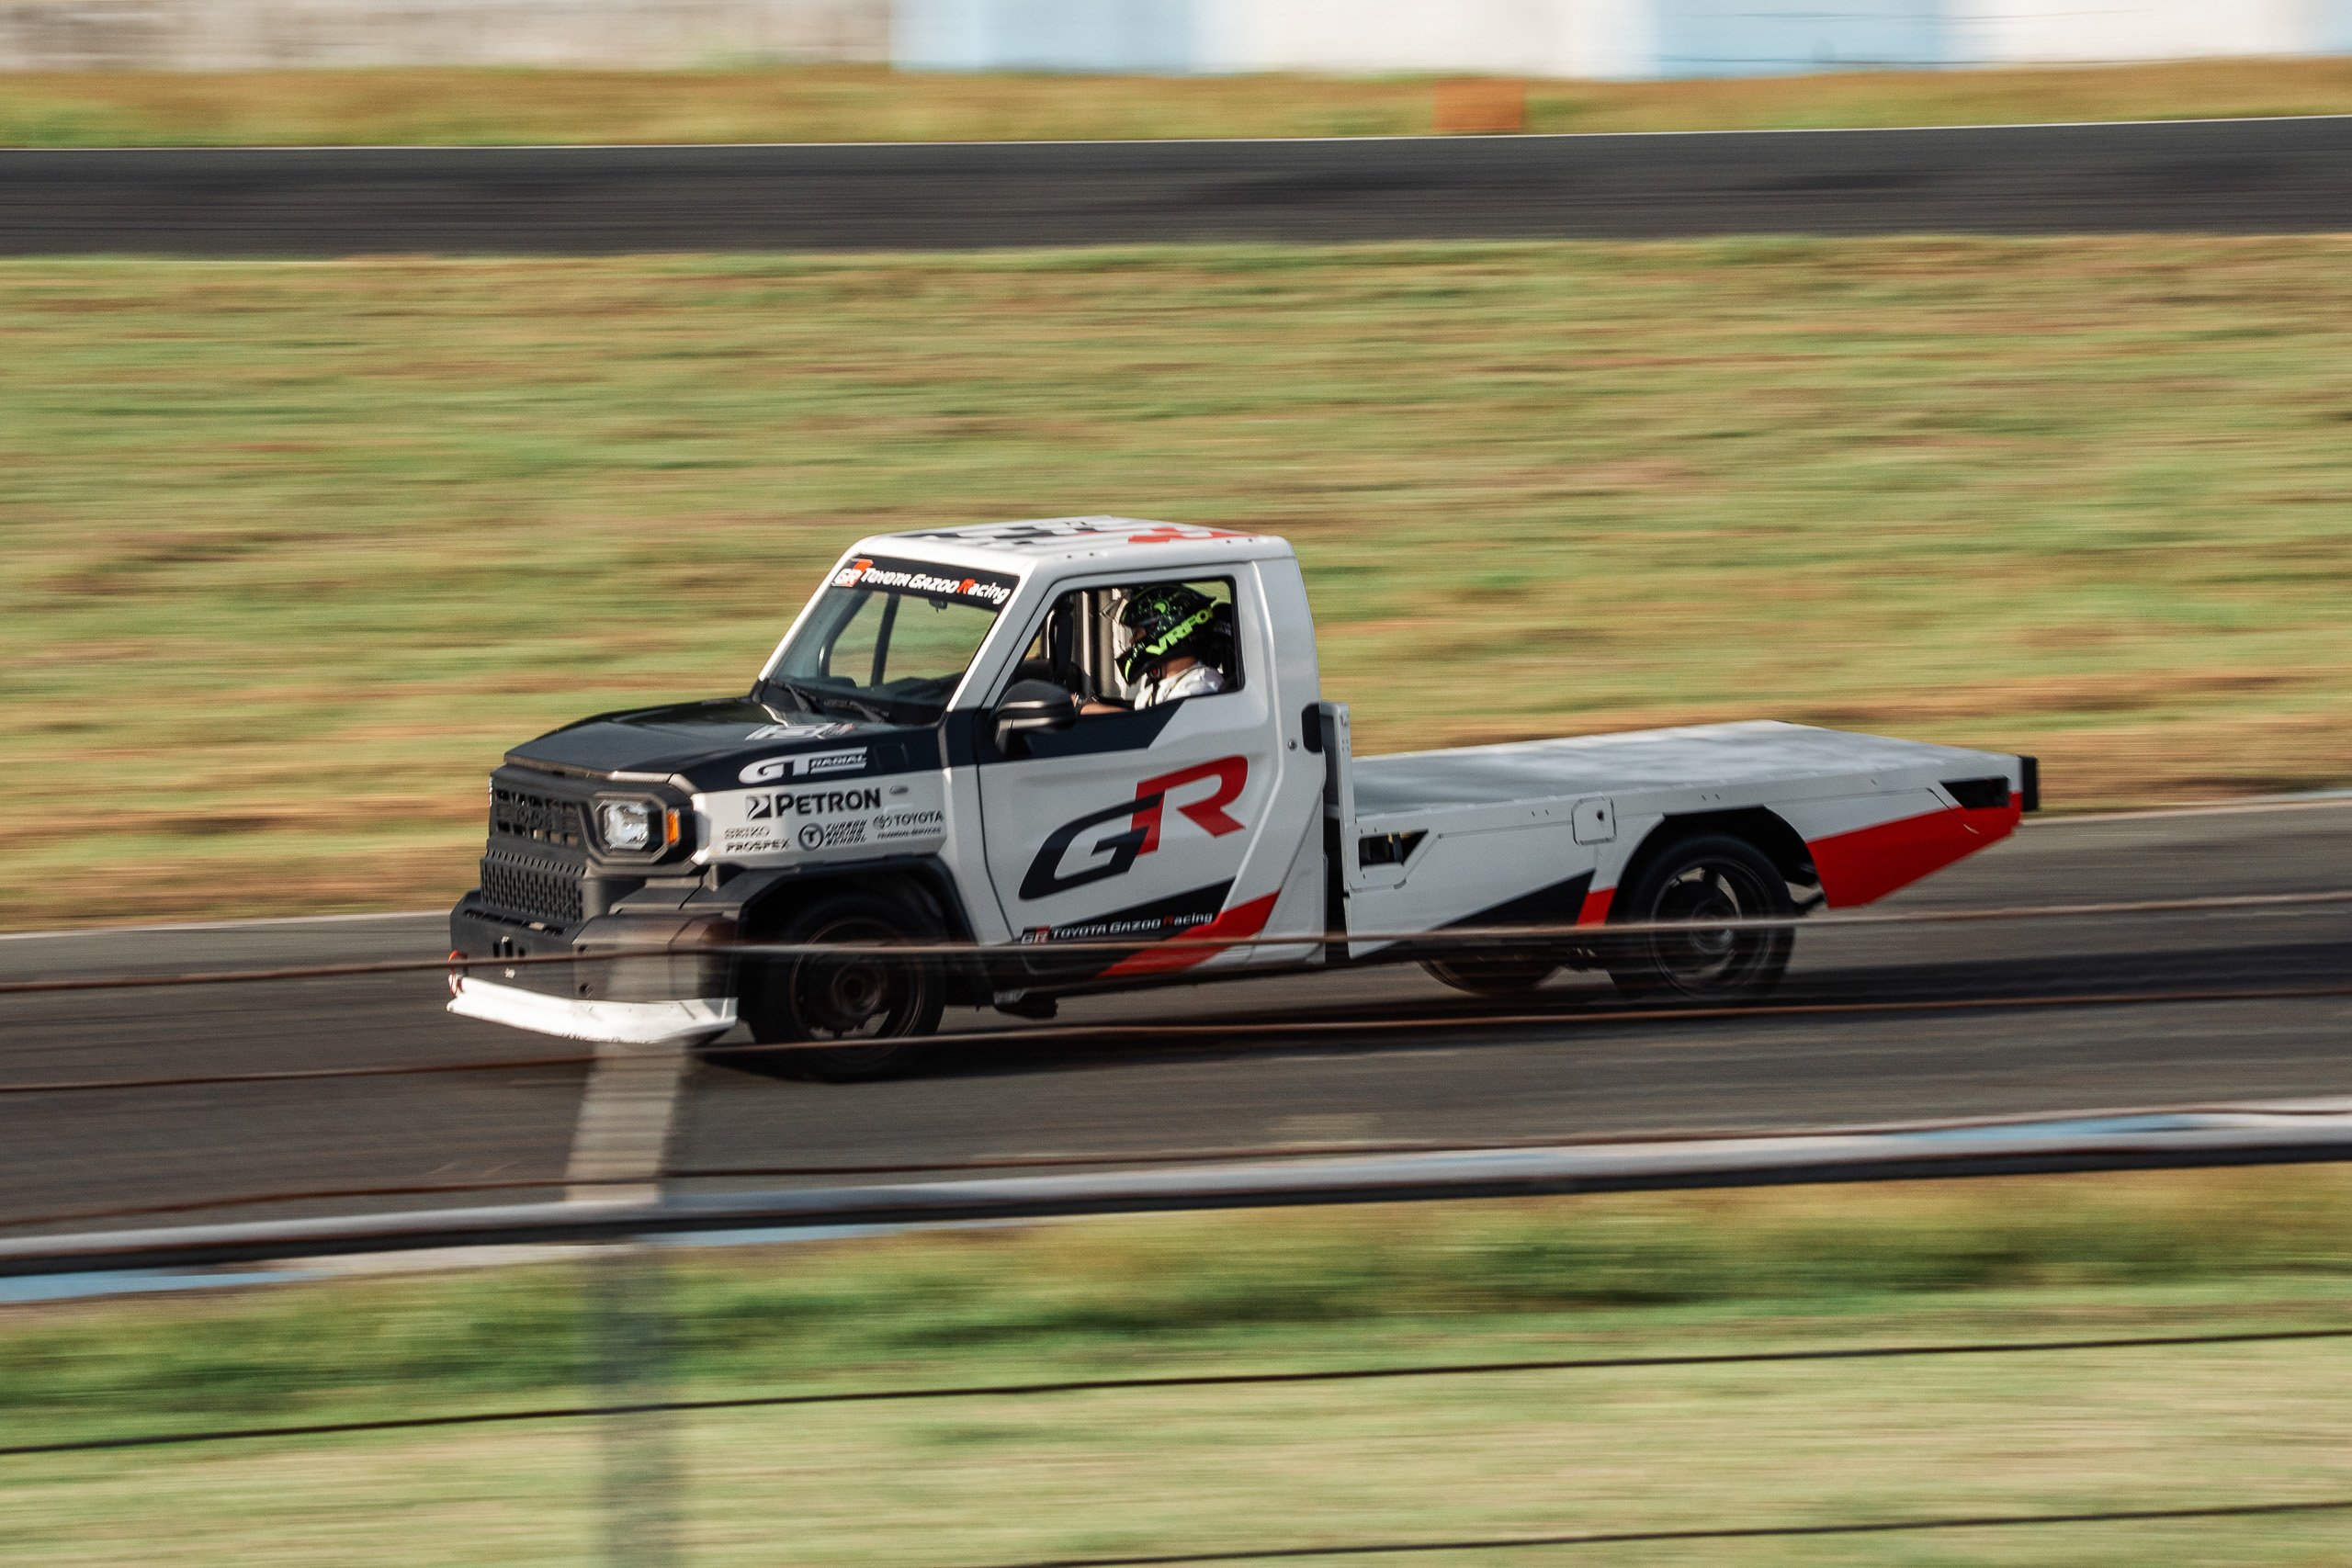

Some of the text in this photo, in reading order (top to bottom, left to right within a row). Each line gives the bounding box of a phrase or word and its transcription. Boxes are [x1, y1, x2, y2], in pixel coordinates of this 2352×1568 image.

[861, 568, 911, 588] TOYOTA
[909, 573, 960, 593] GAZOO
[956, 579, 1011, 604] Racing
[775, 787, 881, 818] PETRON
[894, 810, 944, 826] TOYOTA
[1018, 754, 1247, 901] GR
[1021, 912, 1213, 944] GR TOYOTA GAZOO Racing
